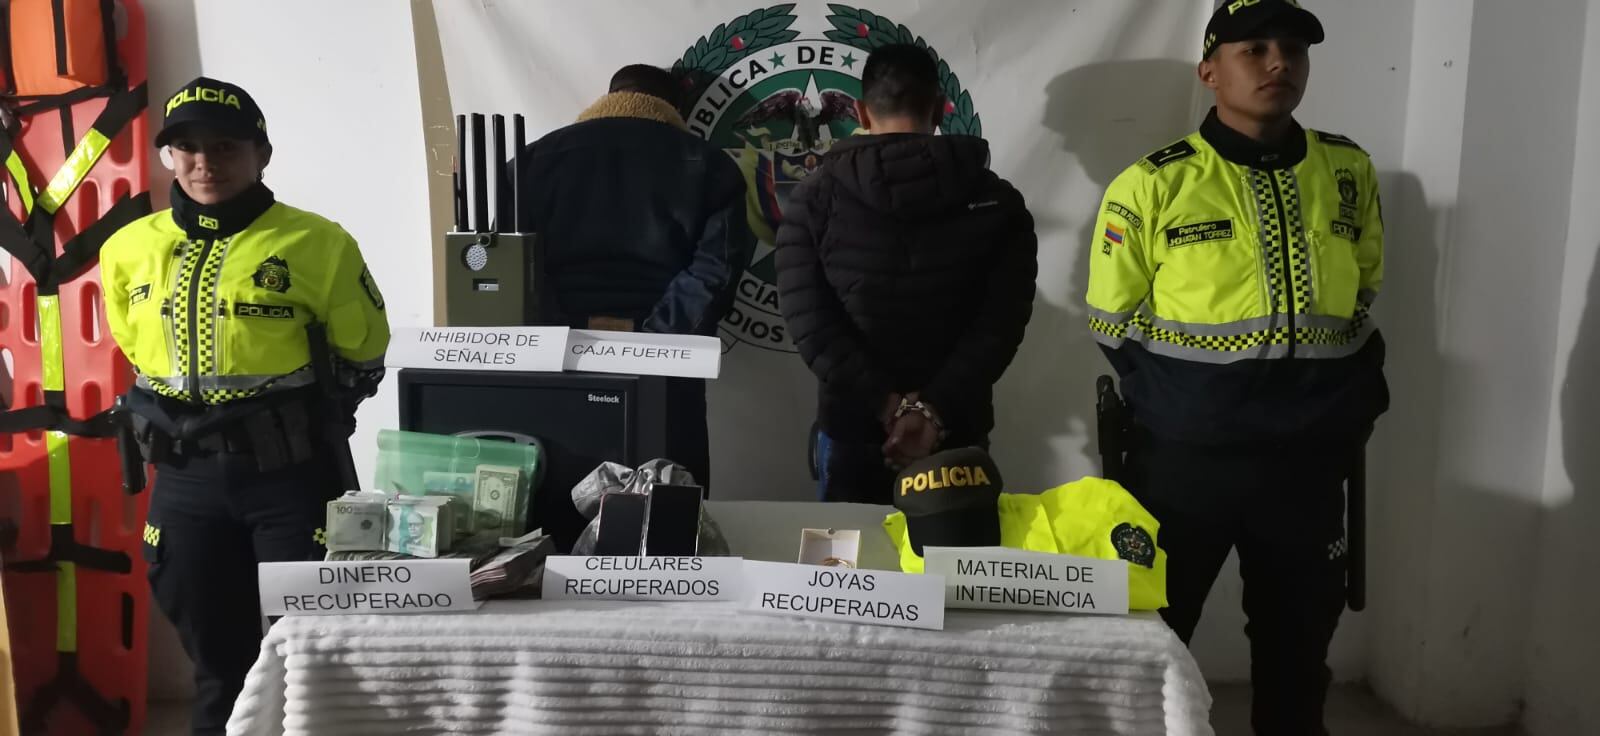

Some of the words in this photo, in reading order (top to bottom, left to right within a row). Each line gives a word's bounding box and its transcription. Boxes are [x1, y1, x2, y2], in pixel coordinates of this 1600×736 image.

[798, 46, 834, 65] DE
[165, 86, 240, 116] POLICÍA
[238, 305, 292, 319] POLICÍA
[724, 308, 785, 343] DIOS
[419, 331, 511, 347] INHIBIDOR
[516, 334, 539, 347] DE
[433, 348, 516, 365] SEÑALES
[572, 344, 616, 357] CAJA
[622, 347, 692, 360] FUERTE
[587, 392, 620, 404] Steelock
[901, 466, 990, 496] POLICIA
[585, 556, 703, 571] CELULARES
[957, 559, 1059, 581] MATERIAL
[1066, 566, 1094, 583] DE
[319, 566, 411, 584] DINERO
[808, 570, 876, 591] JOYAS
[565, 579, 720, 596] RECUPERADOS
[283, 593, 452, 611] RECUPERADO
[956, 585, 1096, 609] INTENDENCIA
[762, 593, 919, 622] RECUPERADAS
